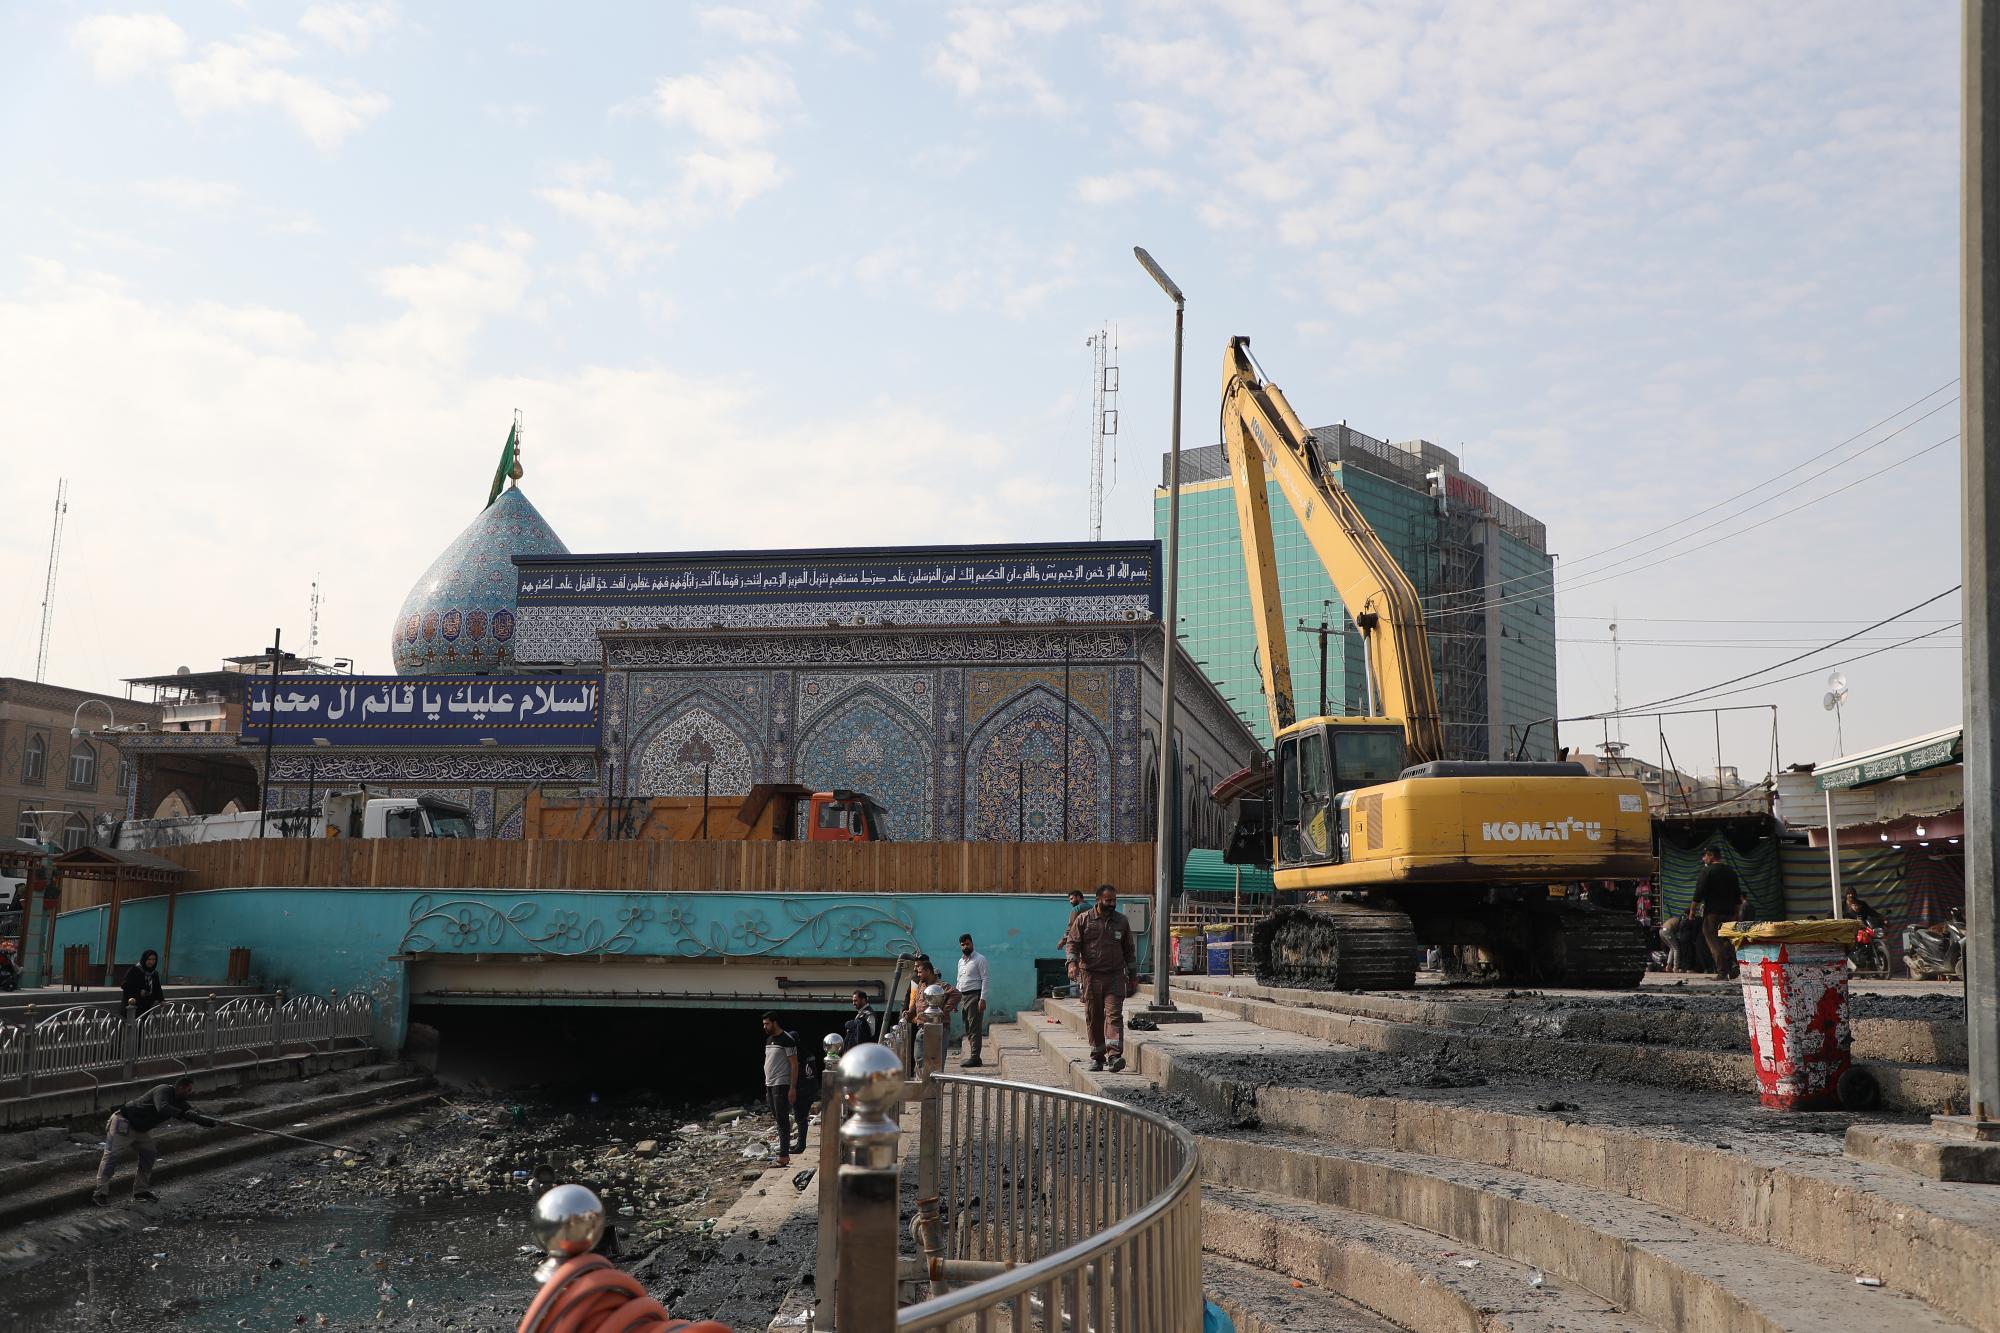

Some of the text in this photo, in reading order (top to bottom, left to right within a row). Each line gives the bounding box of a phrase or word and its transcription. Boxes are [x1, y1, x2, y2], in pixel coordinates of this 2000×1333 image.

[252, 686, 320, 713] محمد
[362, 684, 416, 721] قائم
[422, 685, 442, 720] يا
[448, 686, 516, 721] عليك
[519, 685, 597, 721] السلام
[1482, 816, 1601, 841] KOMATSU
